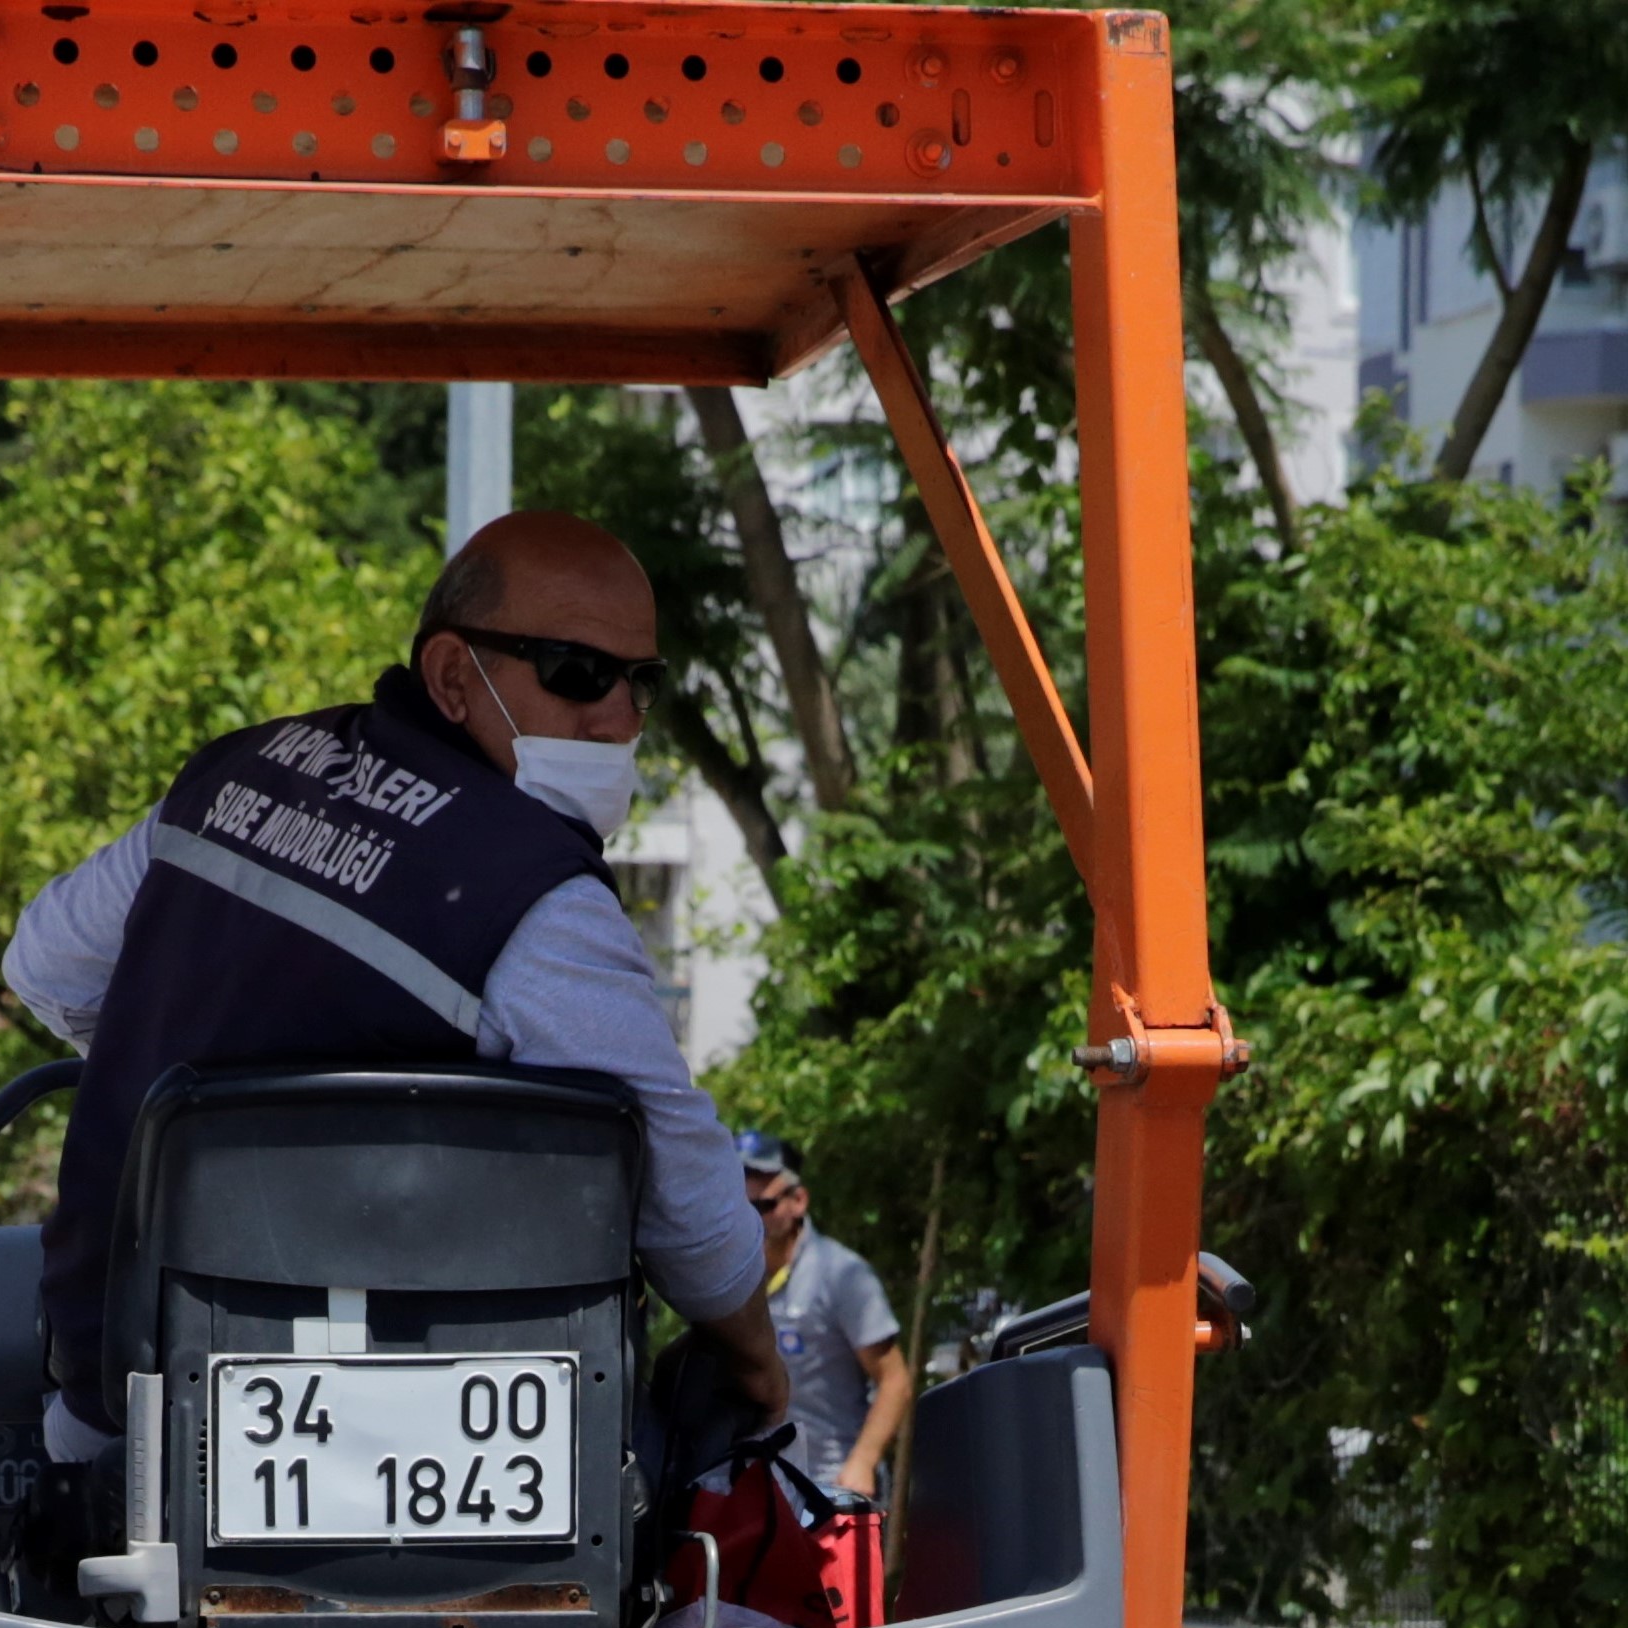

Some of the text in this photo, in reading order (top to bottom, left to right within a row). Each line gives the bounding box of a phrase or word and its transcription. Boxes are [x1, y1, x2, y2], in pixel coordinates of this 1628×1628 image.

[326, 740, 461, 827] İŞLERİ
[197, 781, 396, 895] ŞUBE MÜDÜRLÜĞÜ
[244, 1372, 547, 1444] 34 00
[255, 1455, 543, 1527] 11 1843
